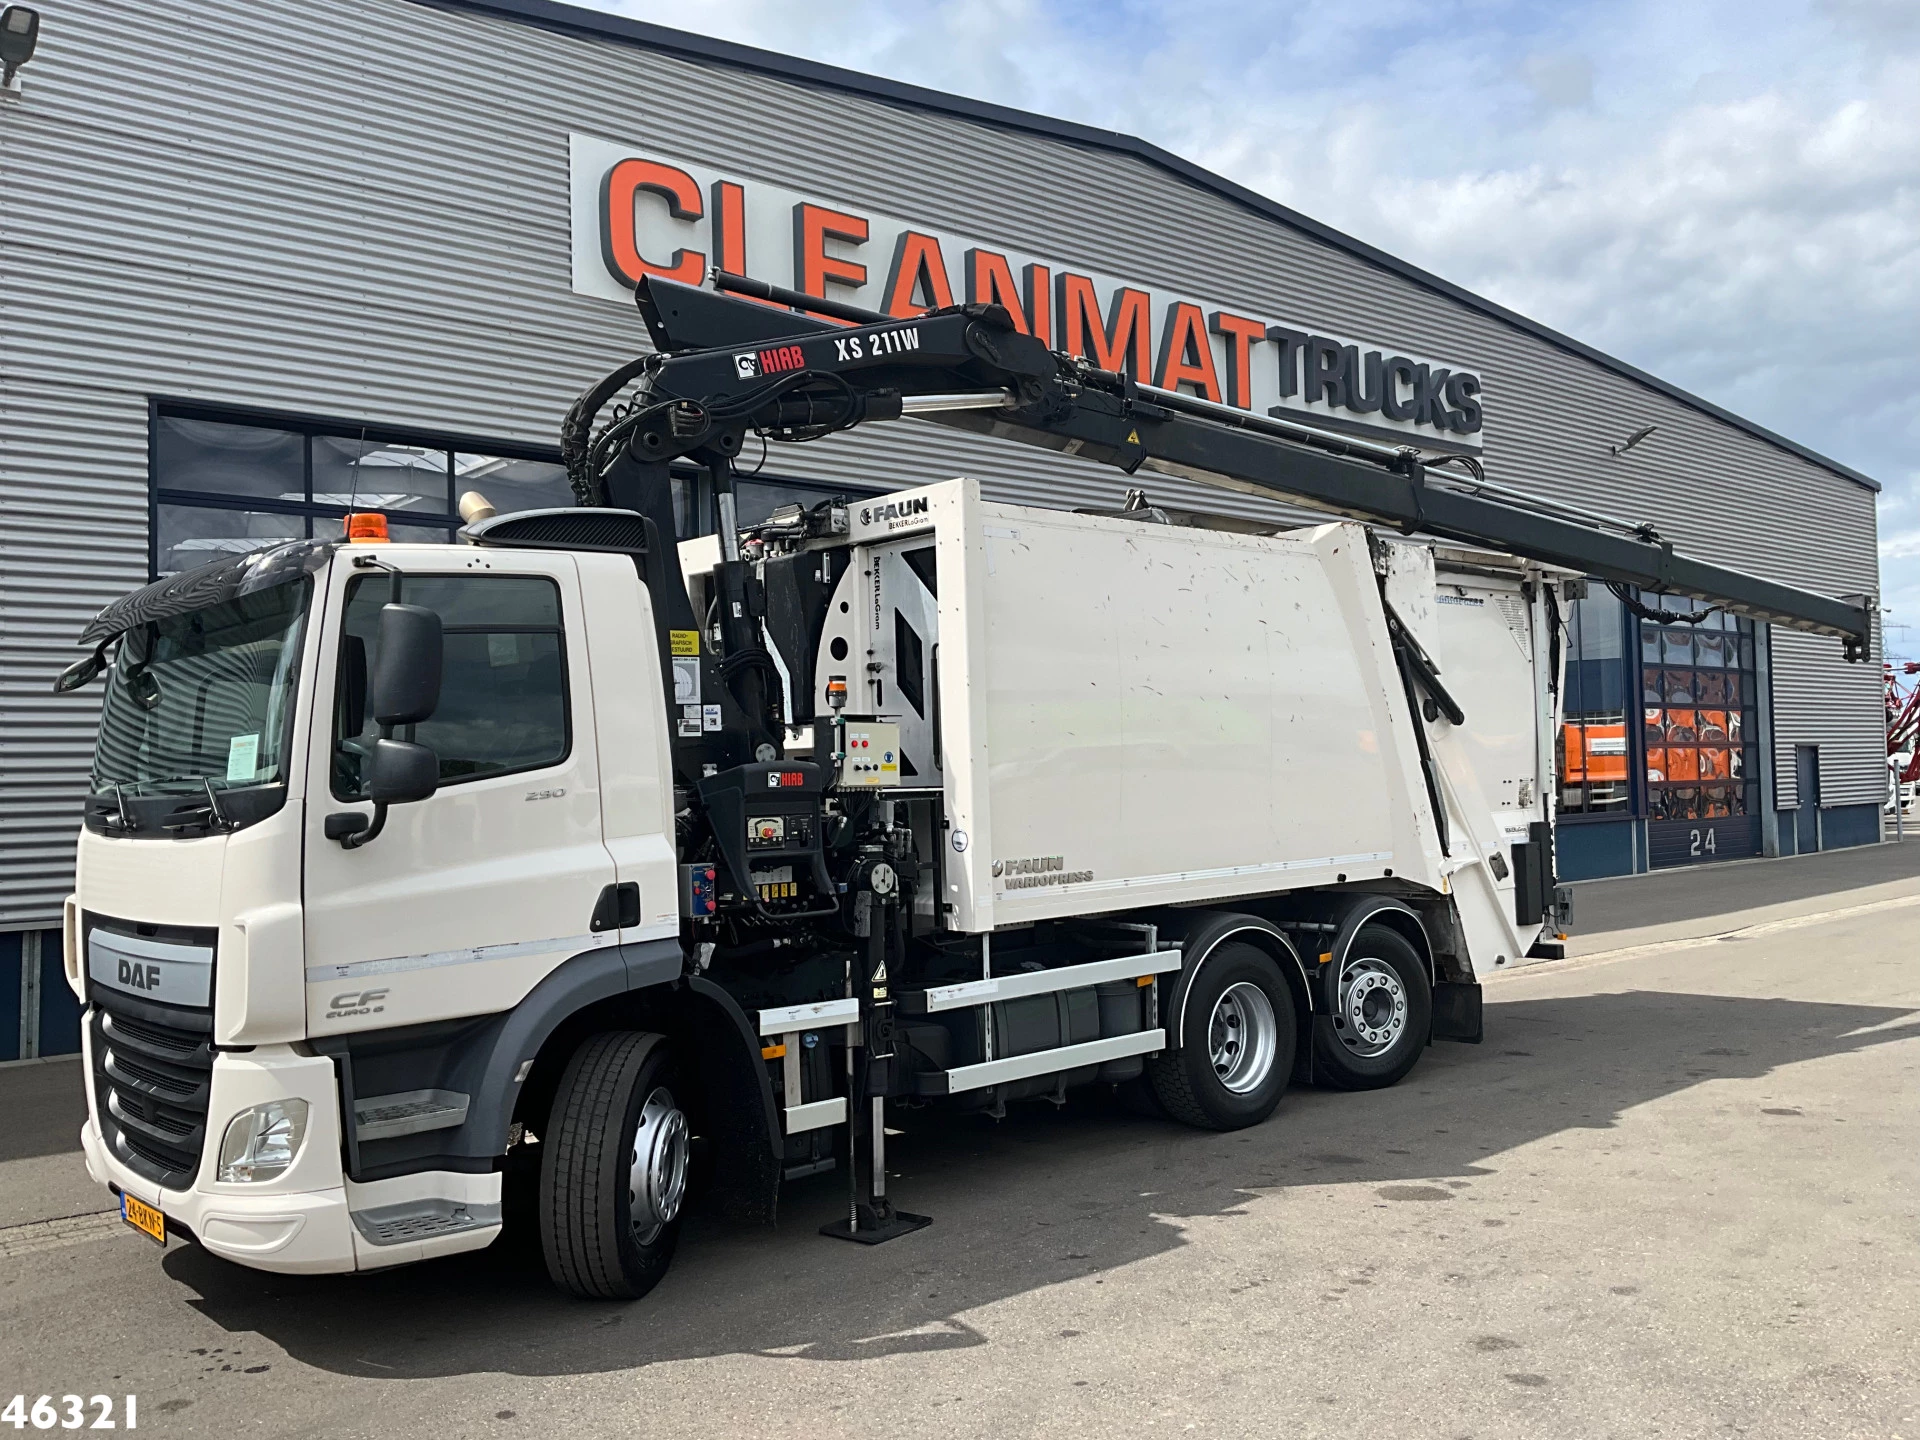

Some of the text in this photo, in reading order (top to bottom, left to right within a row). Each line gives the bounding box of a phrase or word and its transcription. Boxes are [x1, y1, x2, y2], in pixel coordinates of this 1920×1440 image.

[600, 157, 1482, 435] CLEANMAT TRUCKS
[834, 328, 920, 362] XS 211W
[760, 346, 805, 373] HIAB
[873, 496, 928, 523] FAUN
[781, 772, 804, 787] HIAB
[525, 788, 568, 802] 290
[1690, 828, 1716, 857] 24
[1004, 856, 1064, 876] FAUN
[1004, 870, 1094, 890] VARIOPRESS
[117, 958, 161, 991] DAF
[329, 987, 391, 1010] CF
[325, 1005, 385, 1019] EURO 6
